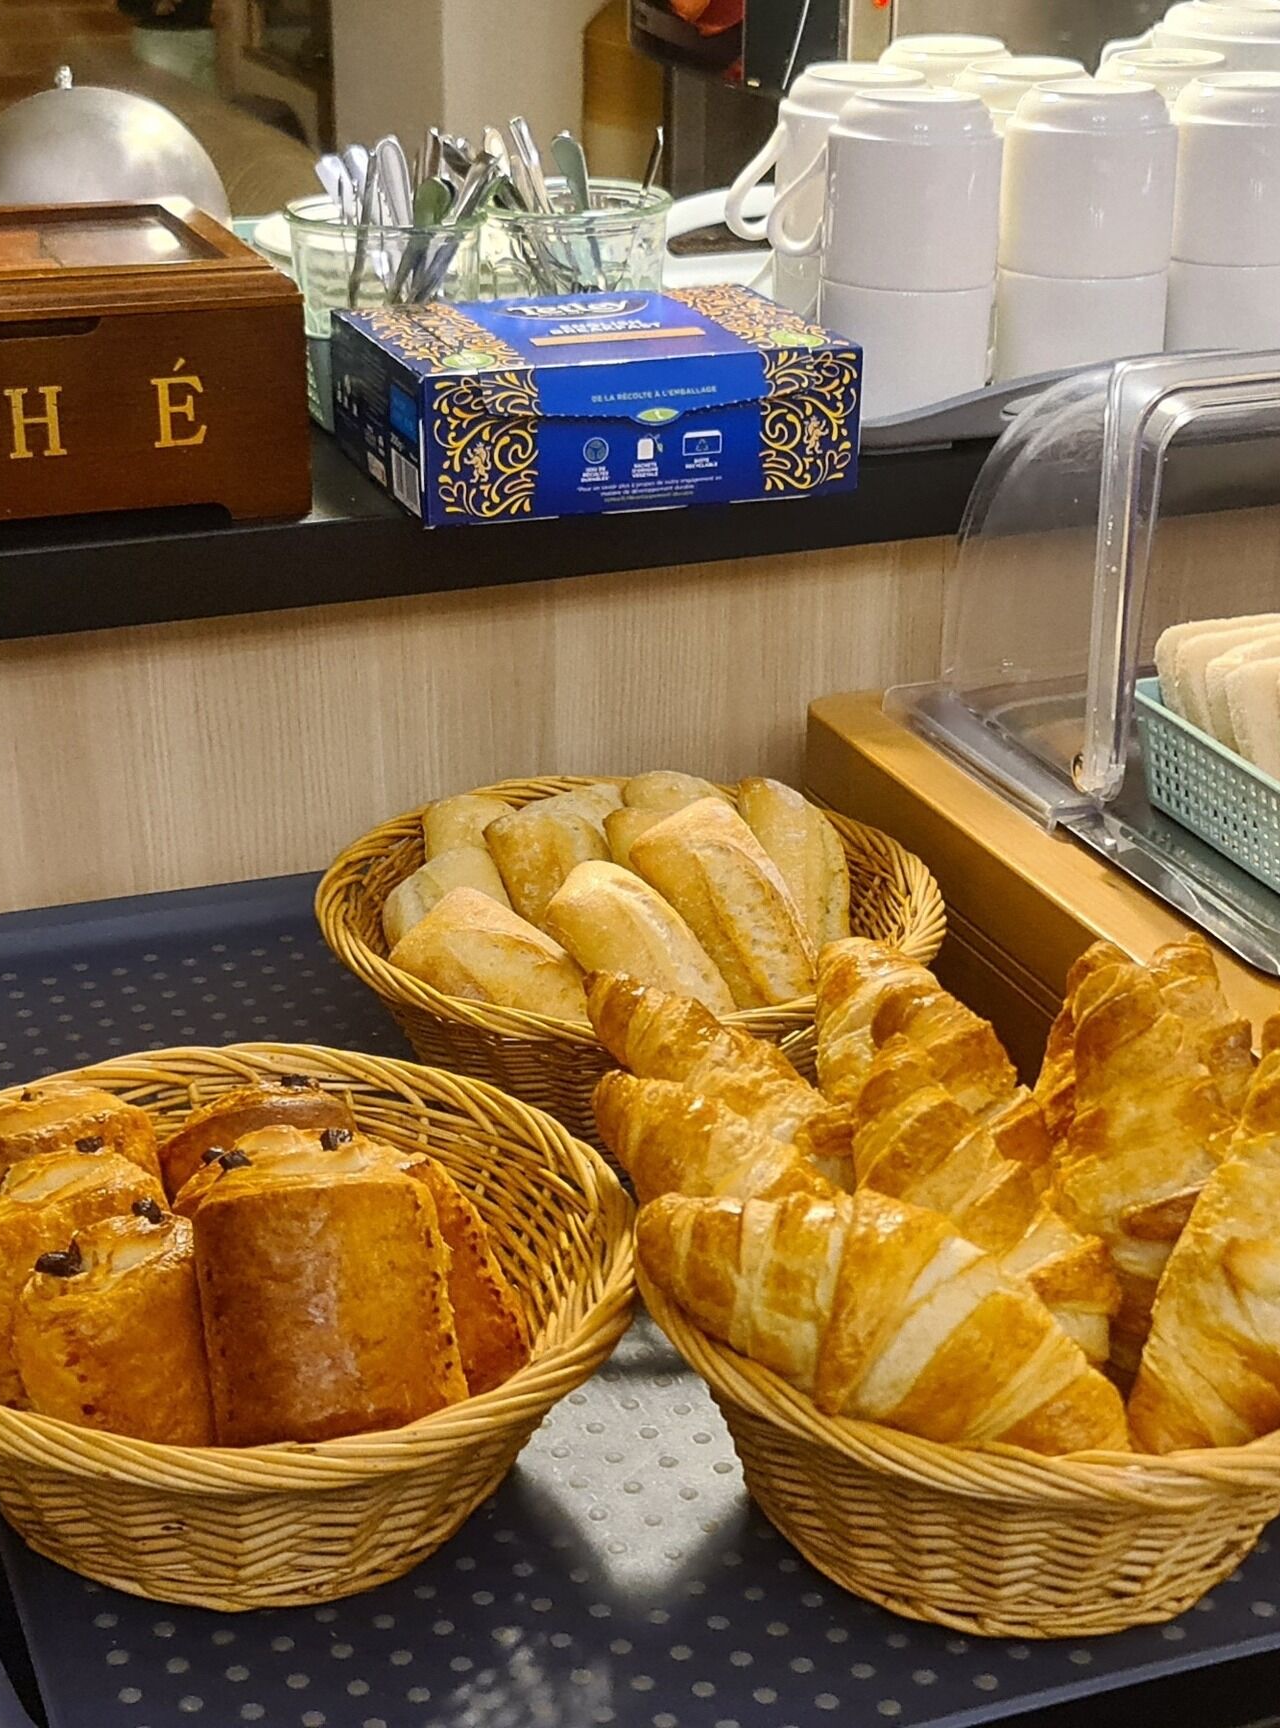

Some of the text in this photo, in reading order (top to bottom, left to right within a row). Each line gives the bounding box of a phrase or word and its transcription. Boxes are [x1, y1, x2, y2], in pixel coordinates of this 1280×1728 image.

[506, 300, 629, 317] Tetley
[591, 395, 603, 403] DE
[604, 394, 616, 402] LA
[617, 391, 653, 401] RÉCOLTE
